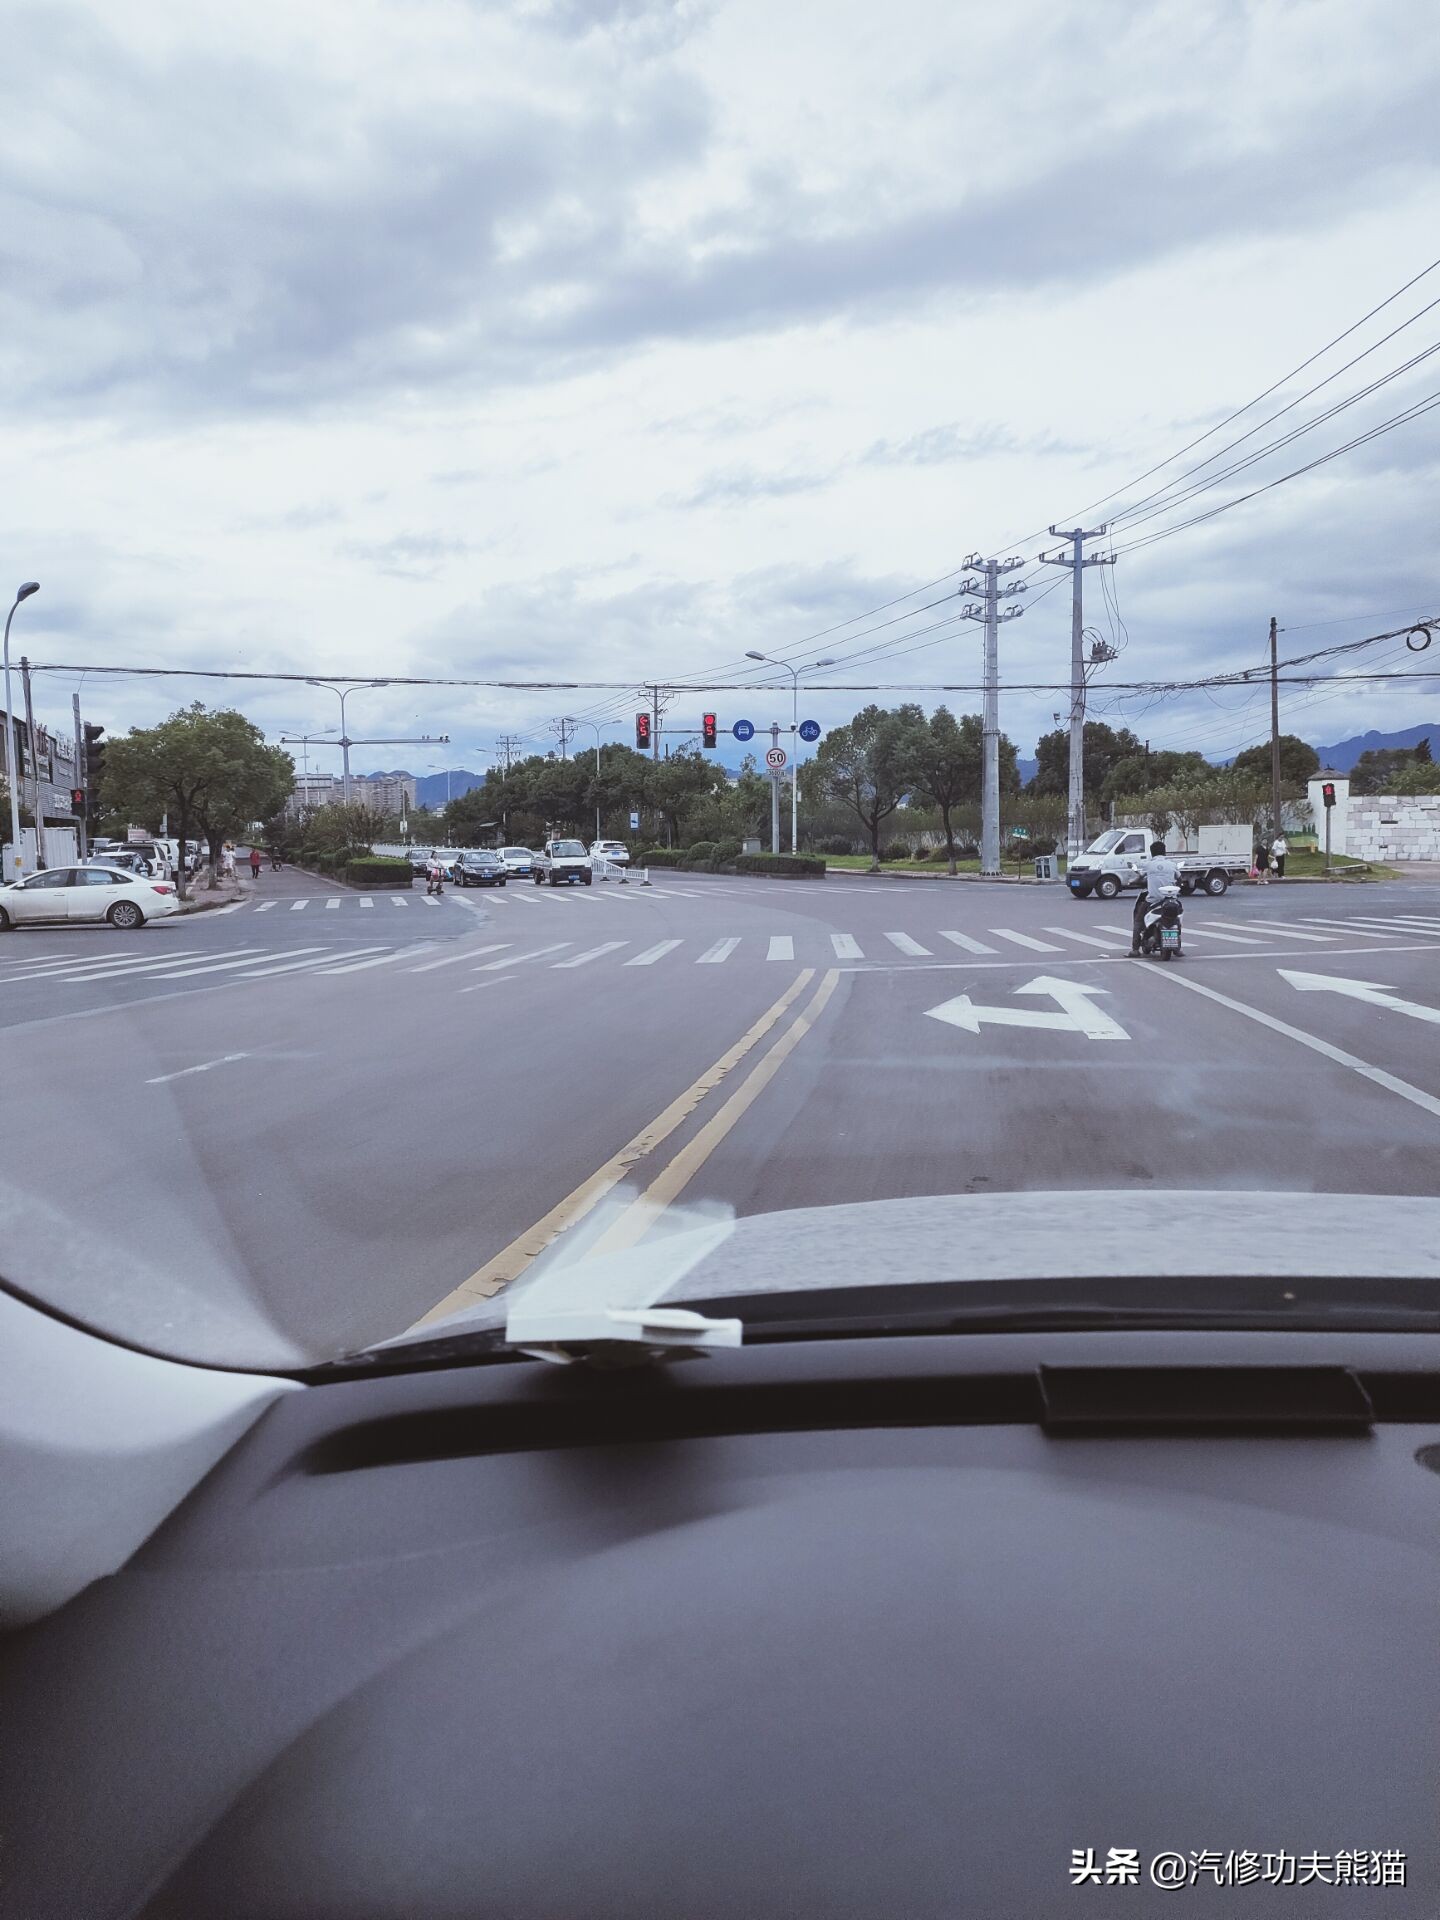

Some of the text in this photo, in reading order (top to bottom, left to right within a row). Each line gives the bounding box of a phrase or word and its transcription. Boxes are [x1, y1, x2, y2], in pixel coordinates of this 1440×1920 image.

[640, 726, 647, 736] 5
[706, 726, 713, 735] 5
[769, 753, 784, 763] 50
